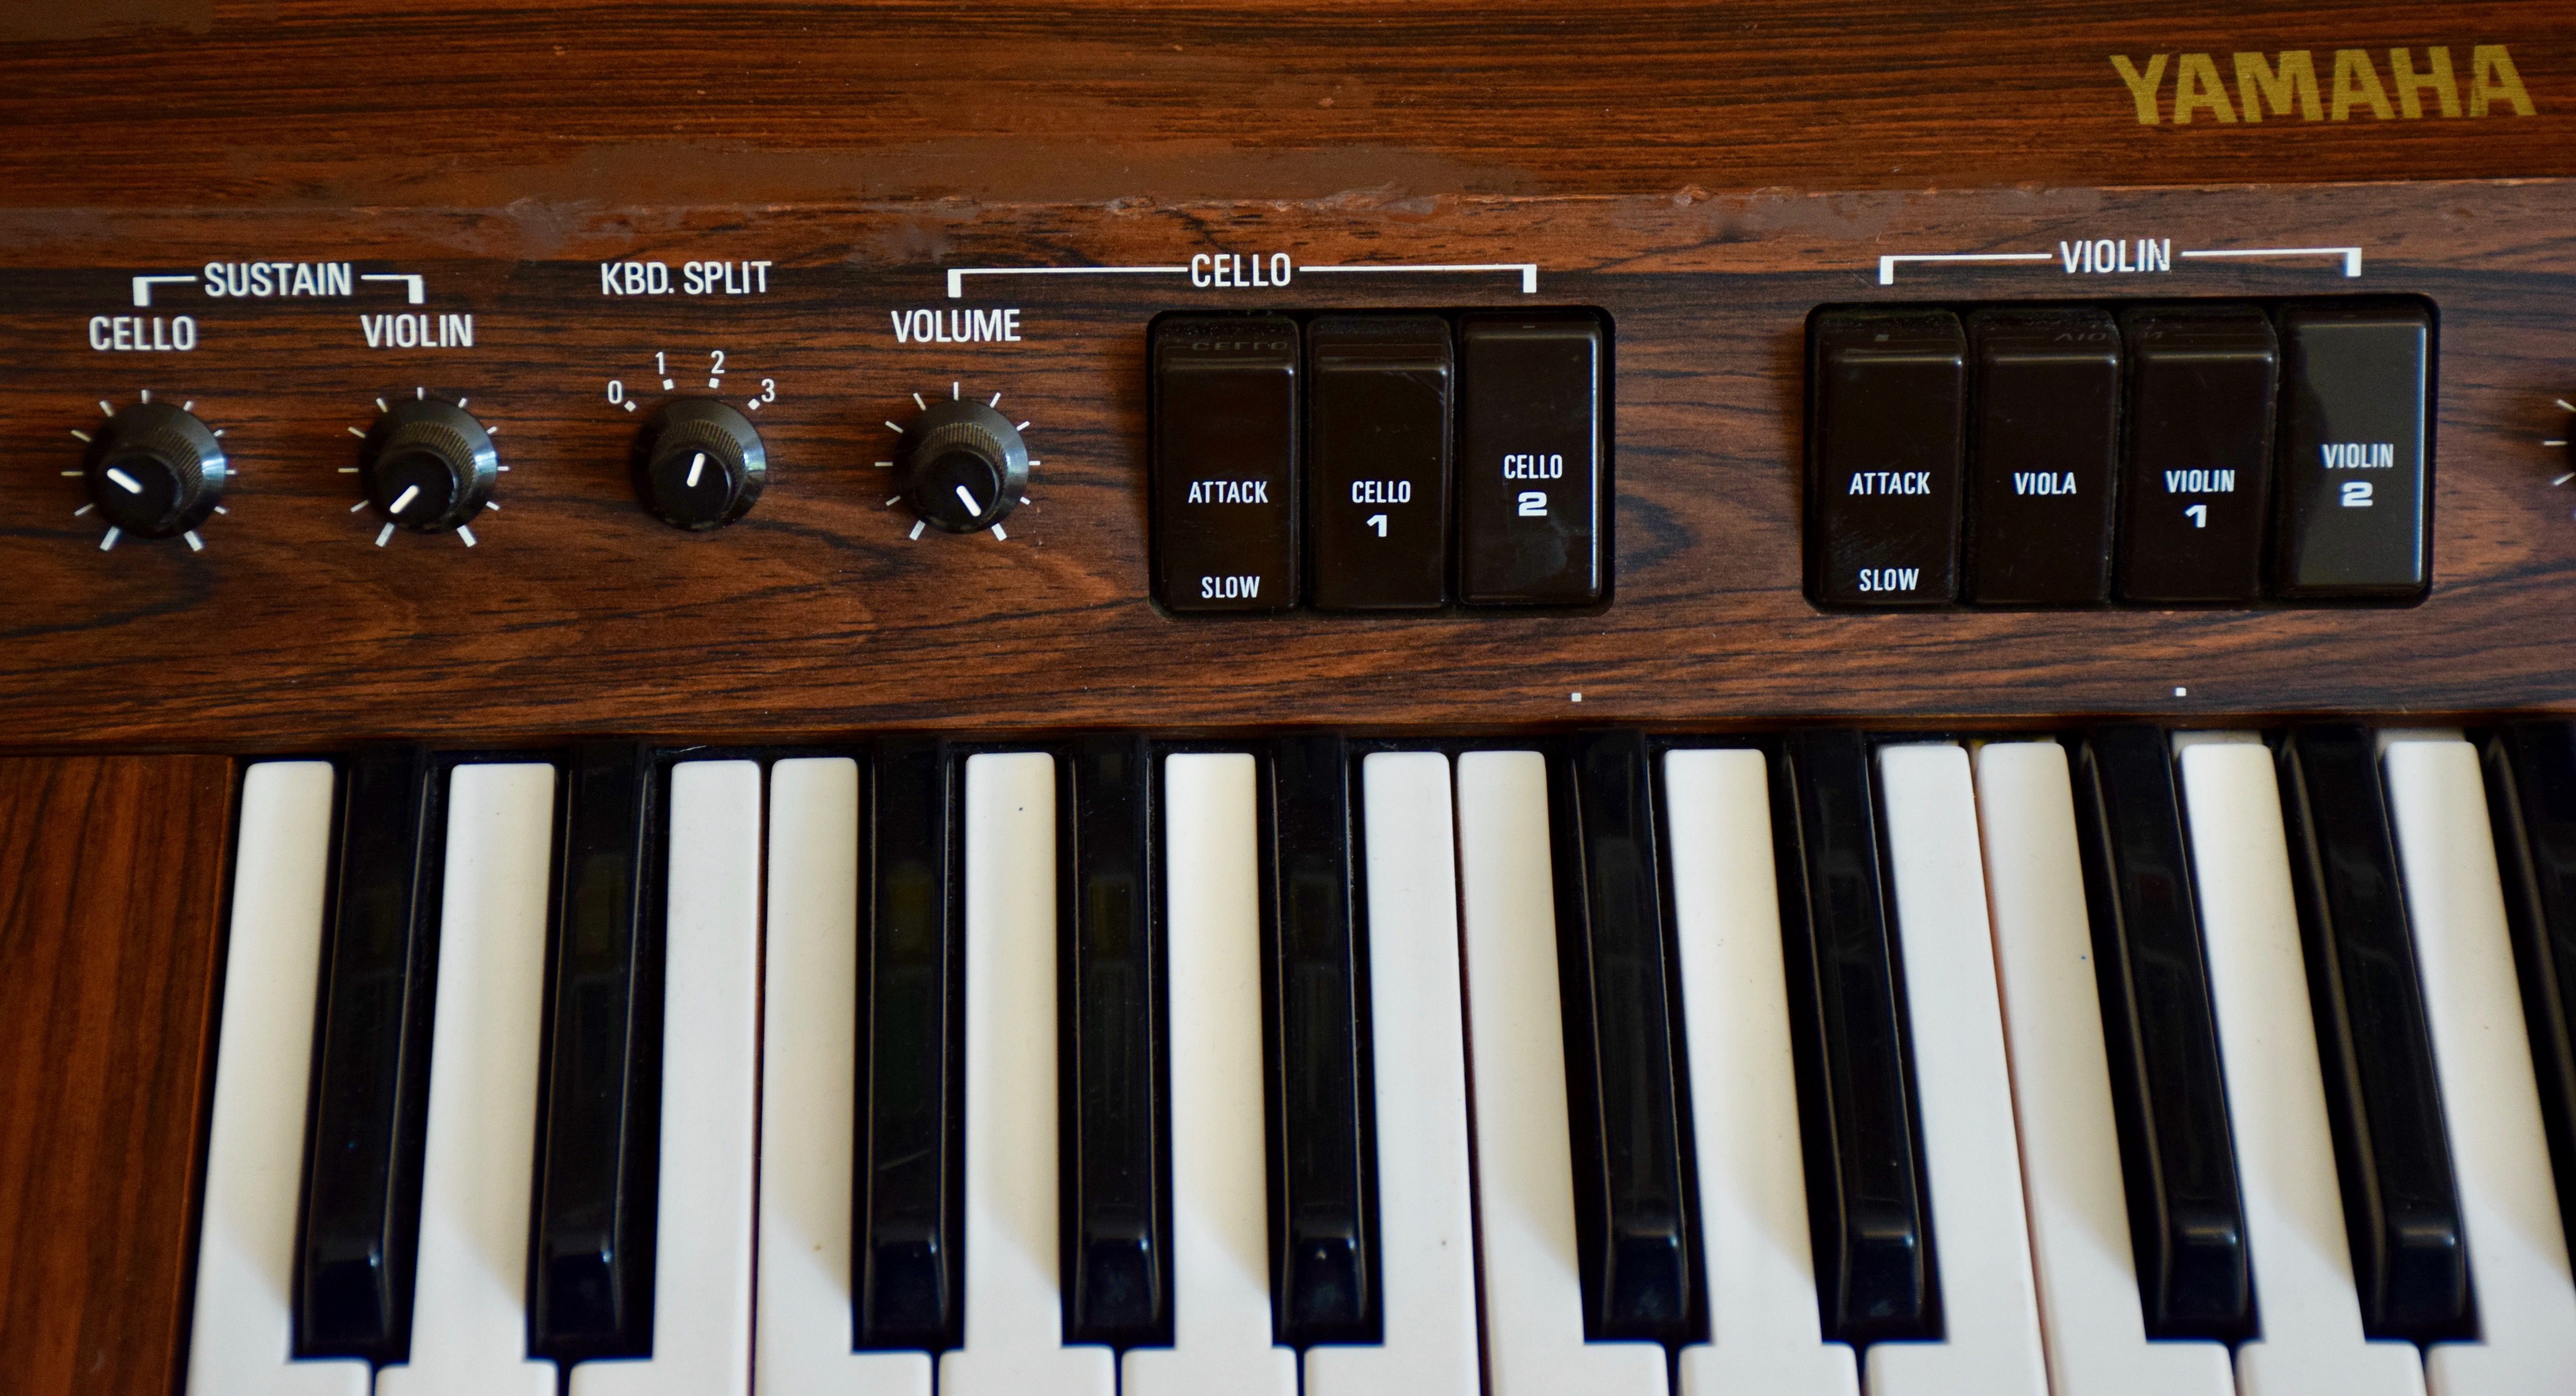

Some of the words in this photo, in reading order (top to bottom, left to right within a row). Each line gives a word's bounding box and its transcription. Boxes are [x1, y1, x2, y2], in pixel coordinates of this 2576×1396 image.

[2110, 44, 2538, 125] YAMAHA
[2061, 238, 2171, 274] VIOLIN
[204, 262, 352, 297] SUSTAIN
[601, 261, 675, 295] KBD.
[683, 260, 772, 295] SPLIT
[1191, 252, 1292, 288] CELLO
[89, 315, 196, 351] CELLO
[360, 314, 473, 348] VIOLIN
[890, 309, 1022, 343] VOLUME
[655, 351, 665, 375] 1
[711, 350, 725, 374] 2
[607, 380, 623, 405] 0
[760, 379, 775, 403] 3
[1504, 454, 1563, 479] CELLO
[2323, 443, 2394, 469] VIOLIN
[1188, 481, 1269, 504] ATTACK
[1352, 480, 1411, 504] CELLO
[1849, 471, 1931, 495] ATTACK
[2015, 472, 2077, 495] VIOLA
[2166, 469, 2235, 493] VIOLIN
[1518, 491, 1548, 517] 2
[2342, 482, 2374, 507] 2
[1366, 514, 1388, 538] 1
[2185, 504, 2207, 528] 1
[1201, 575, 1260, 599] SLOW
[1859, 568, 1920, 592] SLOW
